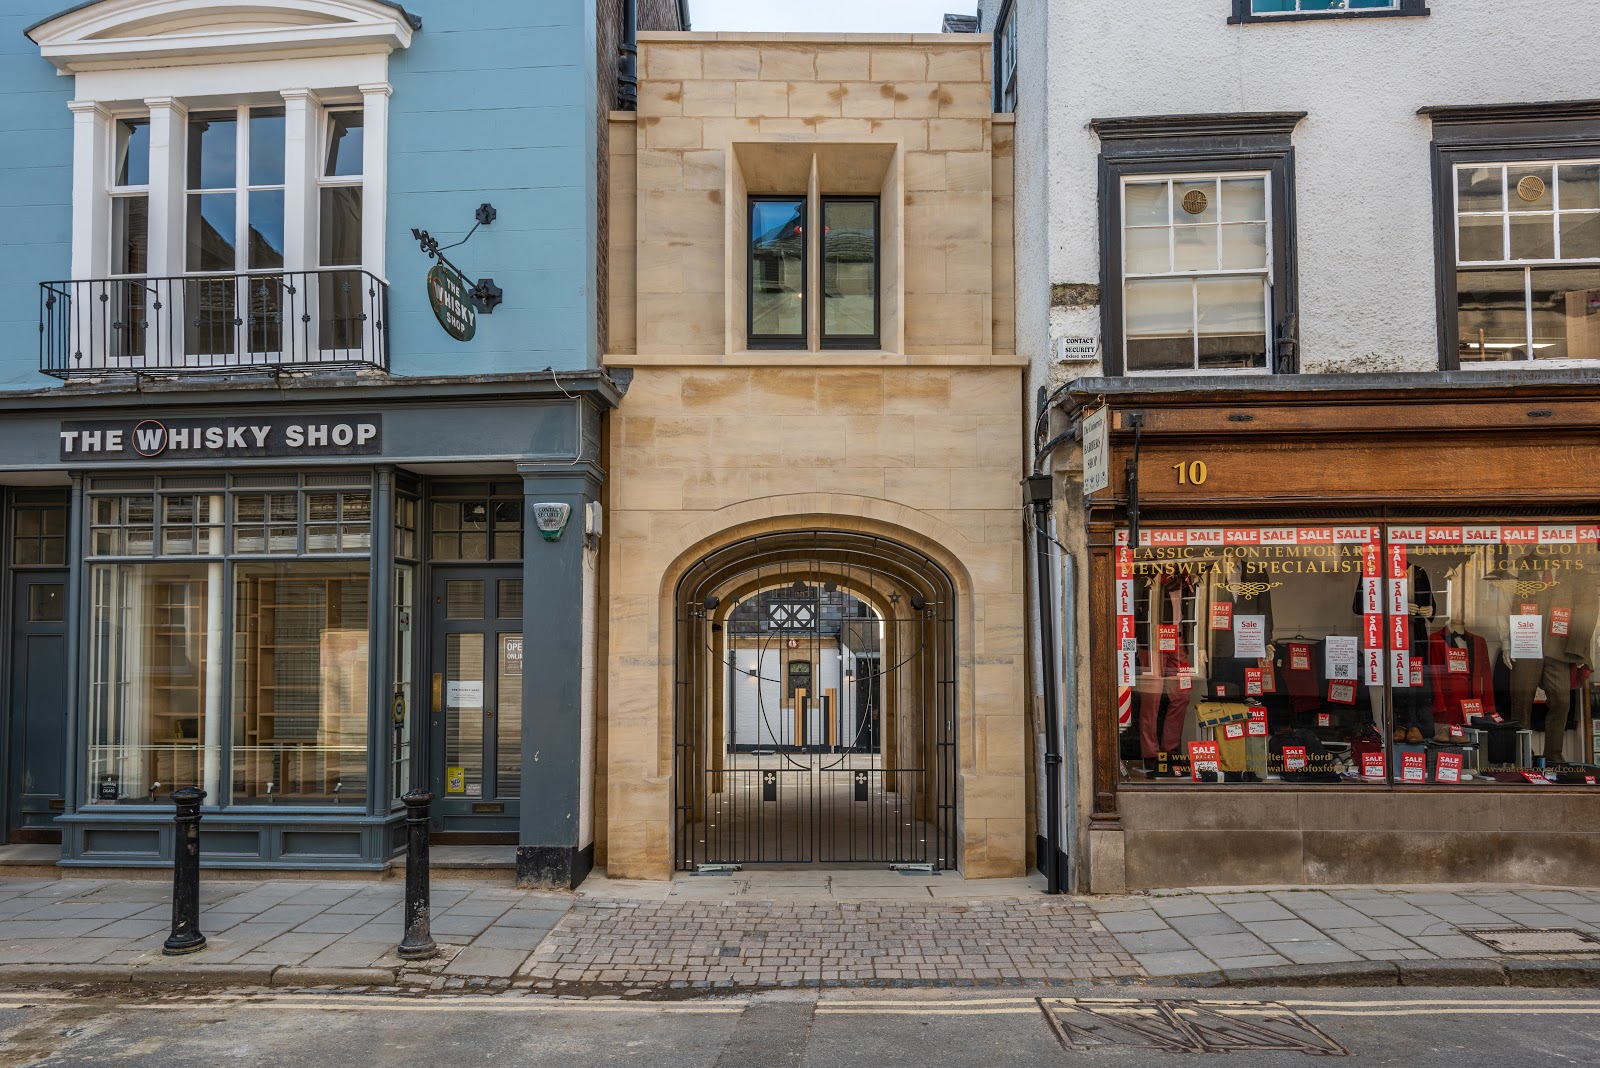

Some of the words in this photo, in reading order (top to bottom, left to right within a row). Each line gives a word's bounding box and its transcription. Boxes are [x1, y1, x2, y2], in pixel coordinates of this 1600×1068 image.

[446, 278, 460, 298] THE
[434, 281, 475, 327] WHISKY
[446, 311, 466, 333] SHOP
[60, 430, 123, 452] THE
[135, 425, 272, 451] WHISKY
[285, 423, 377, 448] SHOP
[1172, 460, 1207, 485] 10
[1154, 532, 1184, 542] SALE
[1190, 532, 1220, 541] SALE
[1226, 531, 1257, 540] SALE
[1263, 531, 1293, 540] SALE
[1300, 530, 1330, 540] SALE
[1337, 530, 1367, 539] SALE
[1392, 530, 1422, 540] SALE
[1428, 530, 1460, 540] SALE
[1466, 530, 1497, 539] SALE
[1504, 530, 1535, 539] SALE
[1542, 530, 1573, 539] SALE
[1580, 530, 1600, 539] SAL
[1202, 547, 1214, 558] &
[1415, 544, 1531, 556] UNIVERSITY
[1121, 562, 1236, 574] MENSWEAR
[1246, 560, 1376, 574] SPECIALISTS
[1393, 546, 1401, 576] SALE
[1465, 560, 1584, 571] SPECIALISTS
[1368, 580, 1376, 611] SALE
[1369, 616, 1377, 647] SALE
[507, 643, 522, 651] OPE
